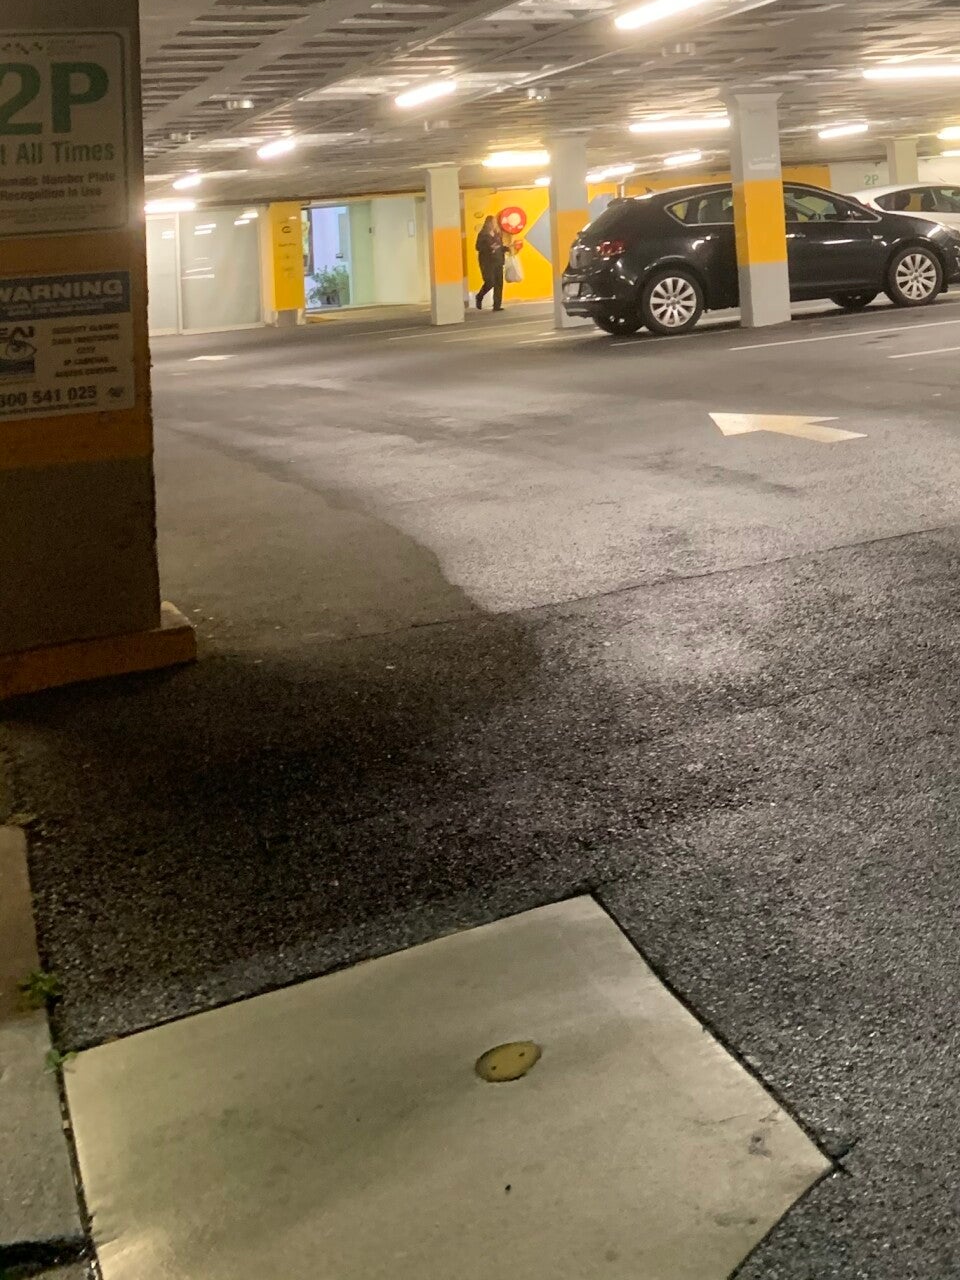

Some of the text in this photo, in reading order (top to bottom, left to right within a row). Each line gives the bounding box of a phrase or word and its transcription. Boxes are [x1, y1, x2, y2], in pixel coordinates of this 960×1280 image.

[0, 62, 109, 135] 2P
[16, 142, 42, 165] All
[51, 141, 114, 164] Times
